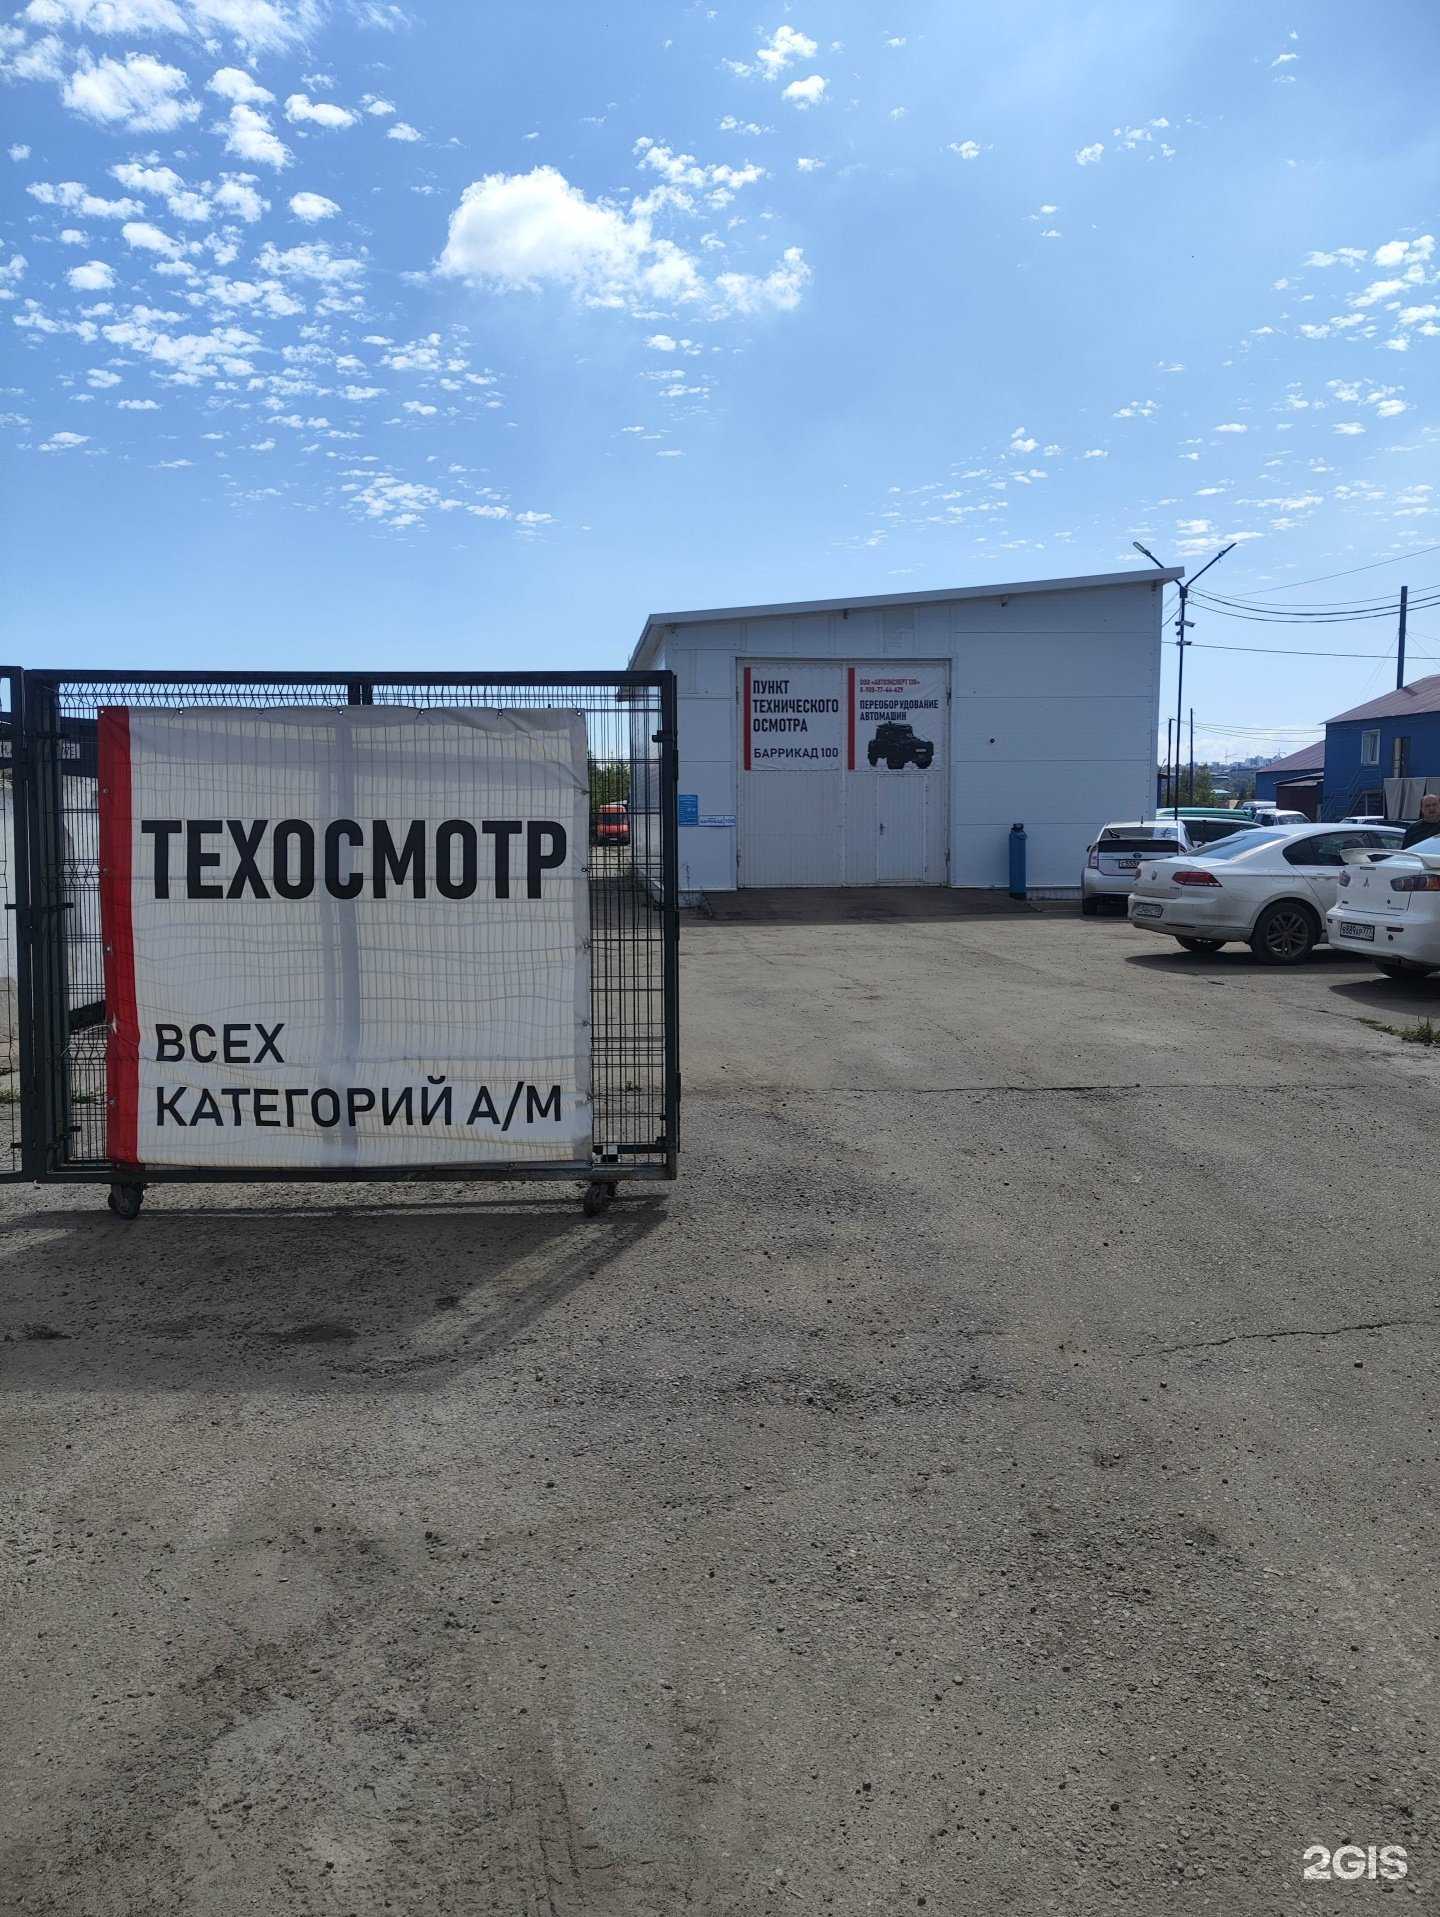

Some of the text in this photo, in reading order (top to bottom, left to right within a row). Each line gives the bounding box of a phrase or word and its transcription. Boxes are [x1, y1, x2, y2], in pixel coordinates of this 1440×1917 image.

[752, 680, 790, 694] ПУНКТ
[753, 699, 839, 713] ТЕХНИЧЕСКОГО
[860, 700, 939, 710] ПЕРЕОБОРУДОВАНИЕ
[860, 712, 907, 721] АВТОМАШИН
[753, 719, 808, 732] ОСМОТРА
[754, 748, 839, 759] БАРРИКАД 100
[141, 819, 567, 900] ТЕХОСМОТР
[156, 1023, 285, 1064] ВСЕХ
[157, 1075, 562, 1131] КАТЕГОРИЙ А/М
